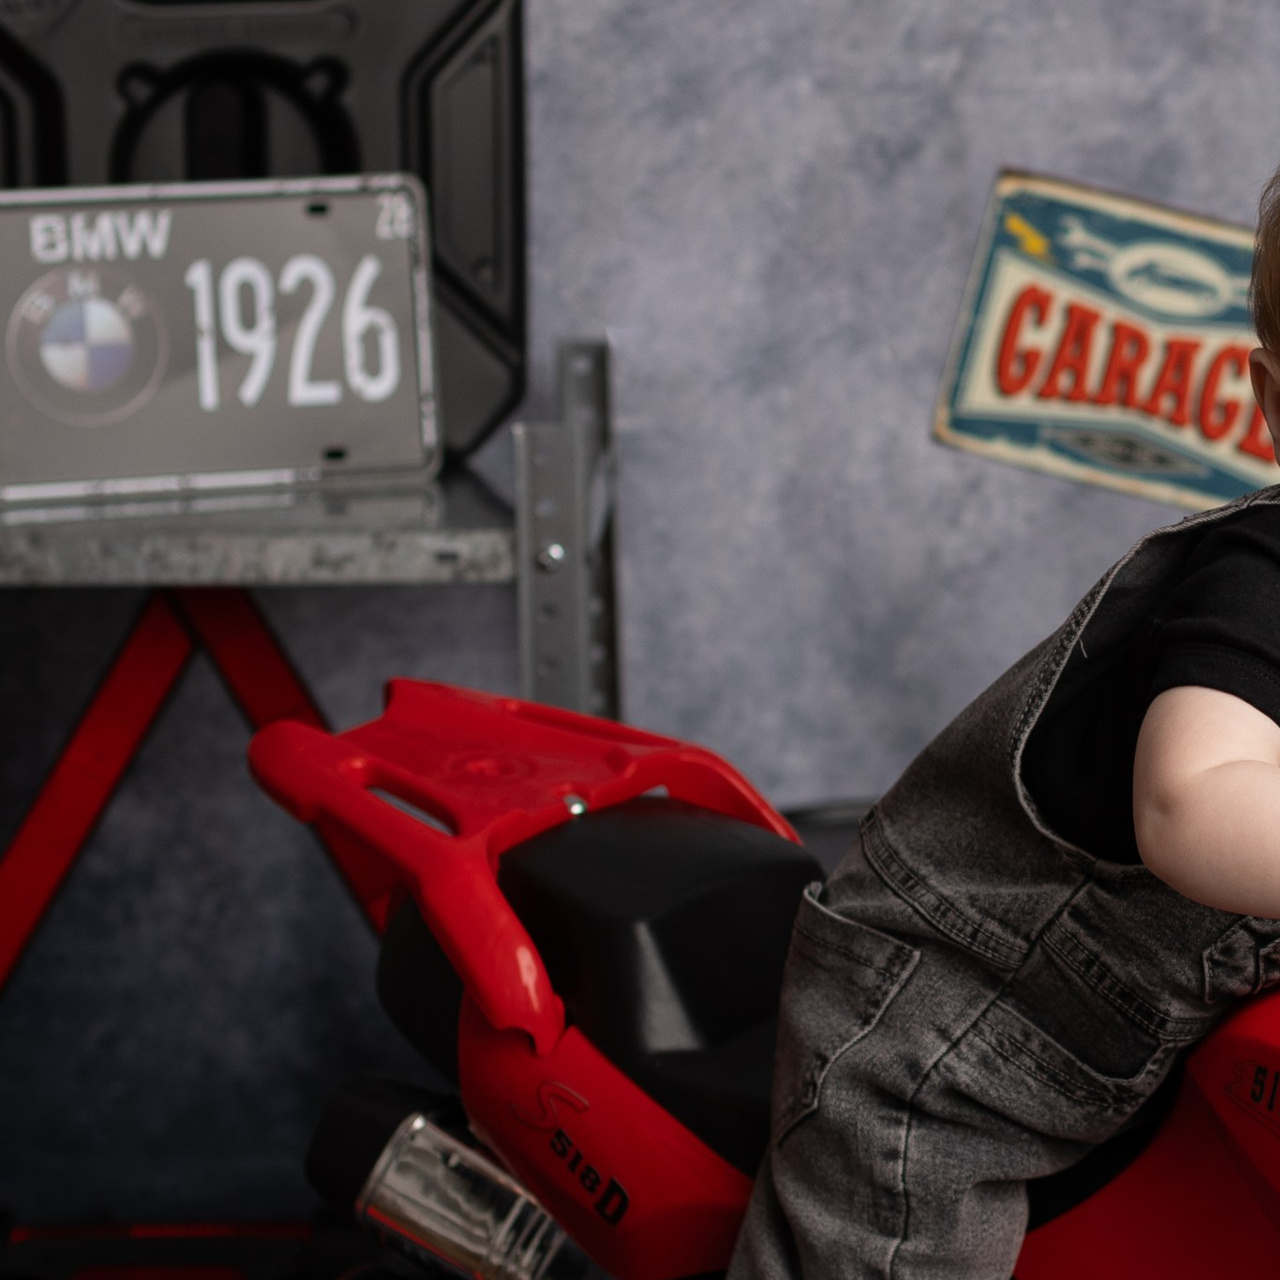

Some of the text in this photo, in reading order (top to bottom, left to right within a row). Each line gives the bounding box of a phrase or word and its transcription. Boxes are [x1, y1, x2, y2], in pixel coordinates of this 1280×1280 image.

[29, 210, 172, 261] BMW
[184, 252, 400, 410] 1926
[550, 1127, 630, 1226] 518D
